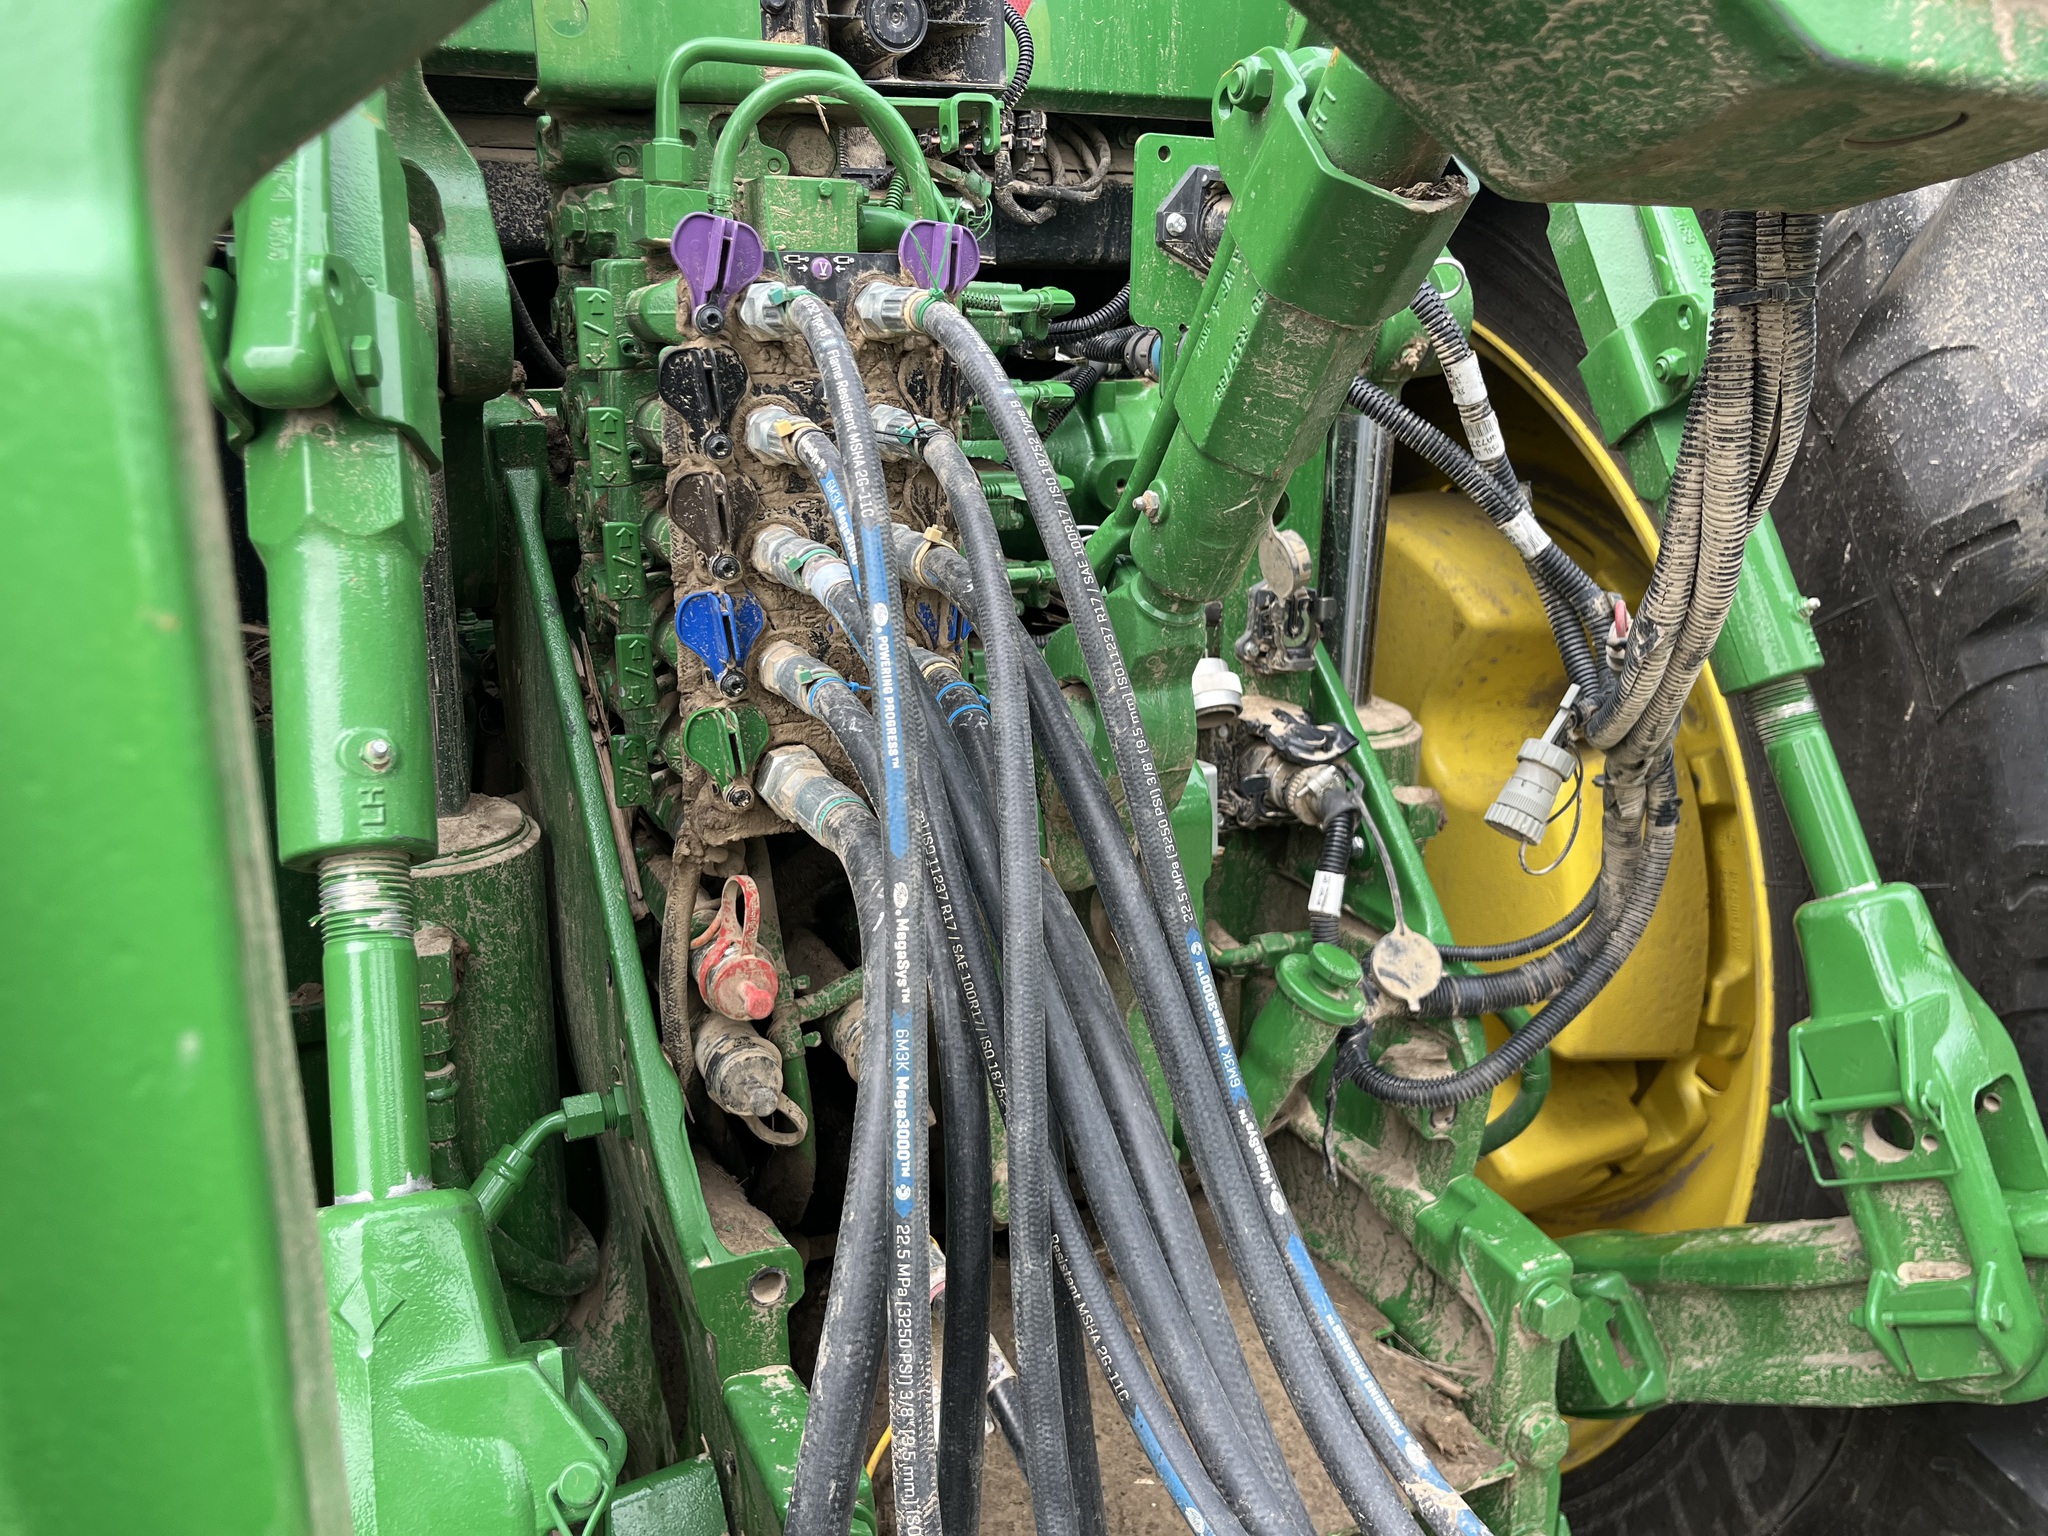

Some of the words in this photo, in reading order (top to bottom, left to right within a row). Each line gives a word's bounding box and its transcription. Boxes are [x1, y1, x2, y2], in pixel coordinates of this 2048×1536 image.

[827, 349, 844, 380] Flame
[836, 380, 857, 432] Resistant
[1010, 400, 1022, 408] B
[1017, 410, 1035, 435] Type
[848, 432, 866, 469] MSHA
[1028, 437, 1053, 474] 18752
[855, 470, 875, 518] 2G-11C
[1045, 477, 1062, 498] ISO
[825, 479, 841, 508] 6M3K
[836, 506, 858, 567] Mega3000
[1058, 509, 1085, 557] 100R17
[1077, 560, 1094, 585] SAE
[1090, 598, 1107, 623] R17
[877, 636, 894, 694] POWERING
[1140, 758, 1156, 786] 3/8"
[358, 787, 386, 826] LH
[1171, 861, 1185, 890] MPa
[1177, 893, 1194, 922] 22.5
[941, 905, 958, 931] R17
[952, 944, 969, 970] SAE
[979, 1035, 995, 1059] ISO
[895, 1028, 910, 1071] 6M3K
[1221, 1049, 1241, 1088] 6M3K
[896, 1224, 911, 1259] 22.5
[897, 1263, 911, 1297] MPa
[1076, 1302, 1102, 1344] MSHA
[1097, 1346, 1130, 1402] 2G-11C
[1364, 1380, 1405, 1437] POWERING
